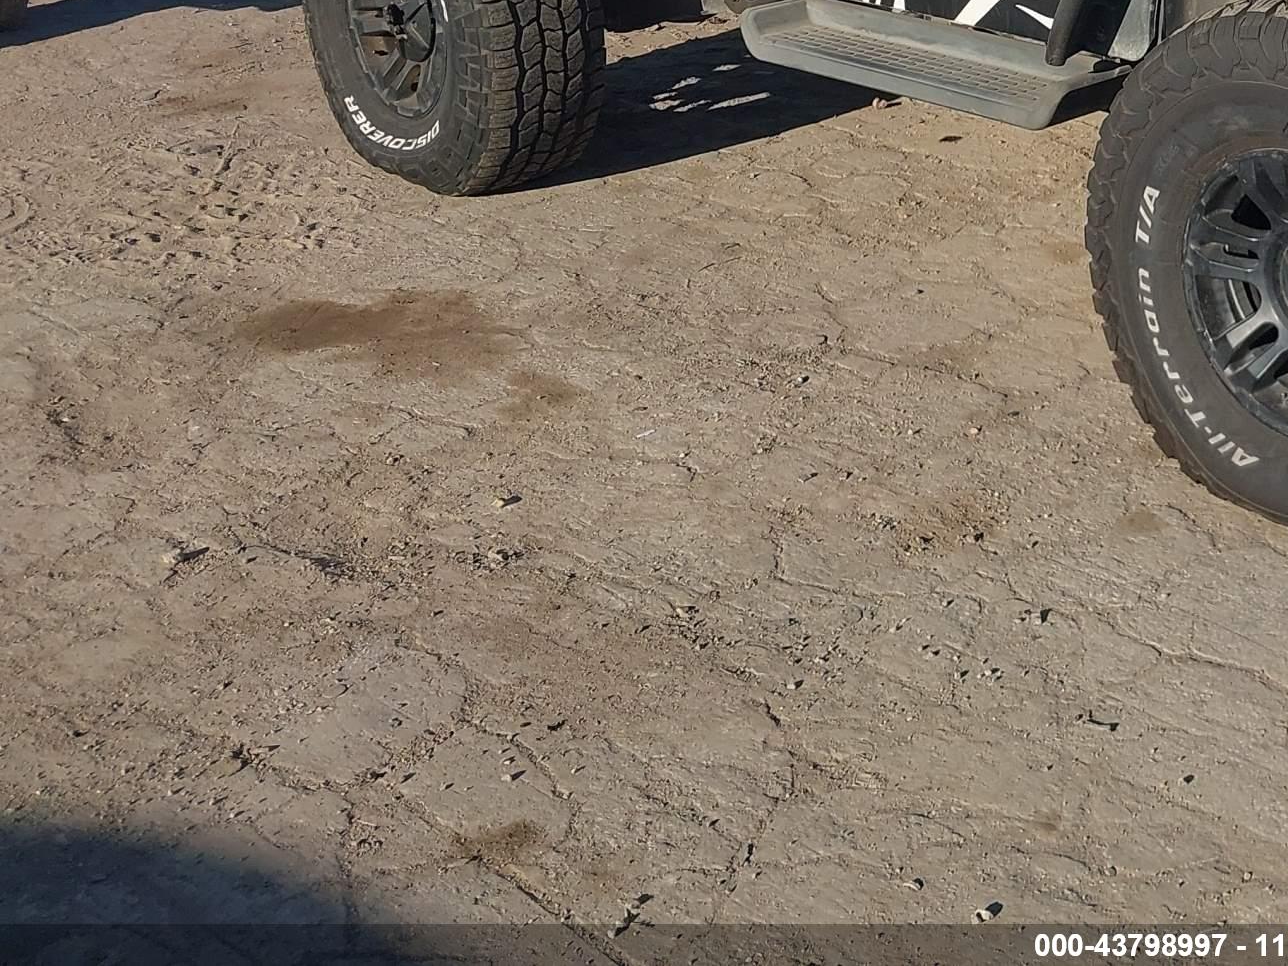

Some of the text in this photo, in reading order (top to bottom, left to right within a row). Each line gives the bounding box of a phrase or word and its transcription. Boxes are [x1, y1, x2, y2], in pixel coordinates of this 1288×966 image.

[343, 94, 440, 151] DISCOVERER
[1134, 185, 1261, 467] All-Terrain T/A
